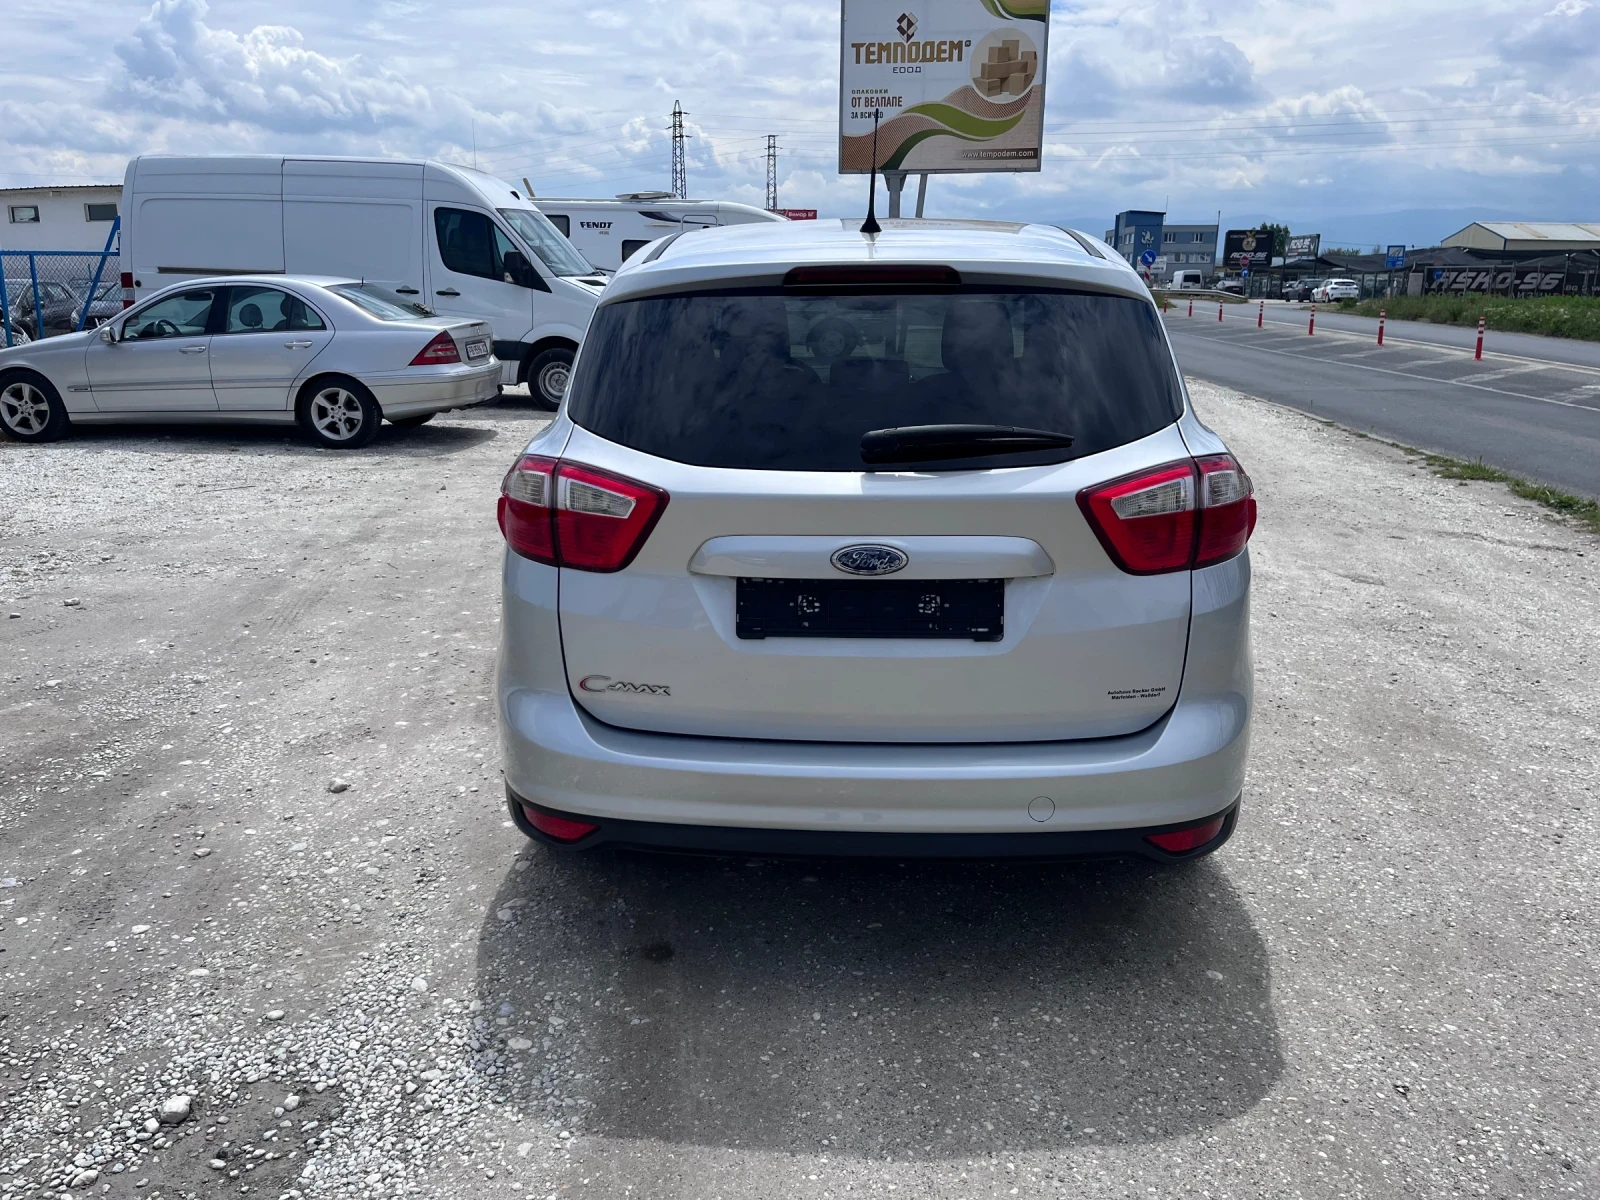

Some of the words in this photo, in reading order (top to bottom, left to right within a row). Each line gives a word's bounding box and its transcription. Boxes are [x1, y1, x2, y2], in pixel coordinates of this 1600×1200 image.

[851, 40, 963, 64] ТЕМПОДЕМ
[851, 96, 862, 108] ОТ
[864, 96, 903, 108] ВЕЛПАПЕ
[850, 111, 859, 119] ЗА
[962, 150, 1034, 159] www.tempodem.com
[580, 221, 613, 229] FENDT
